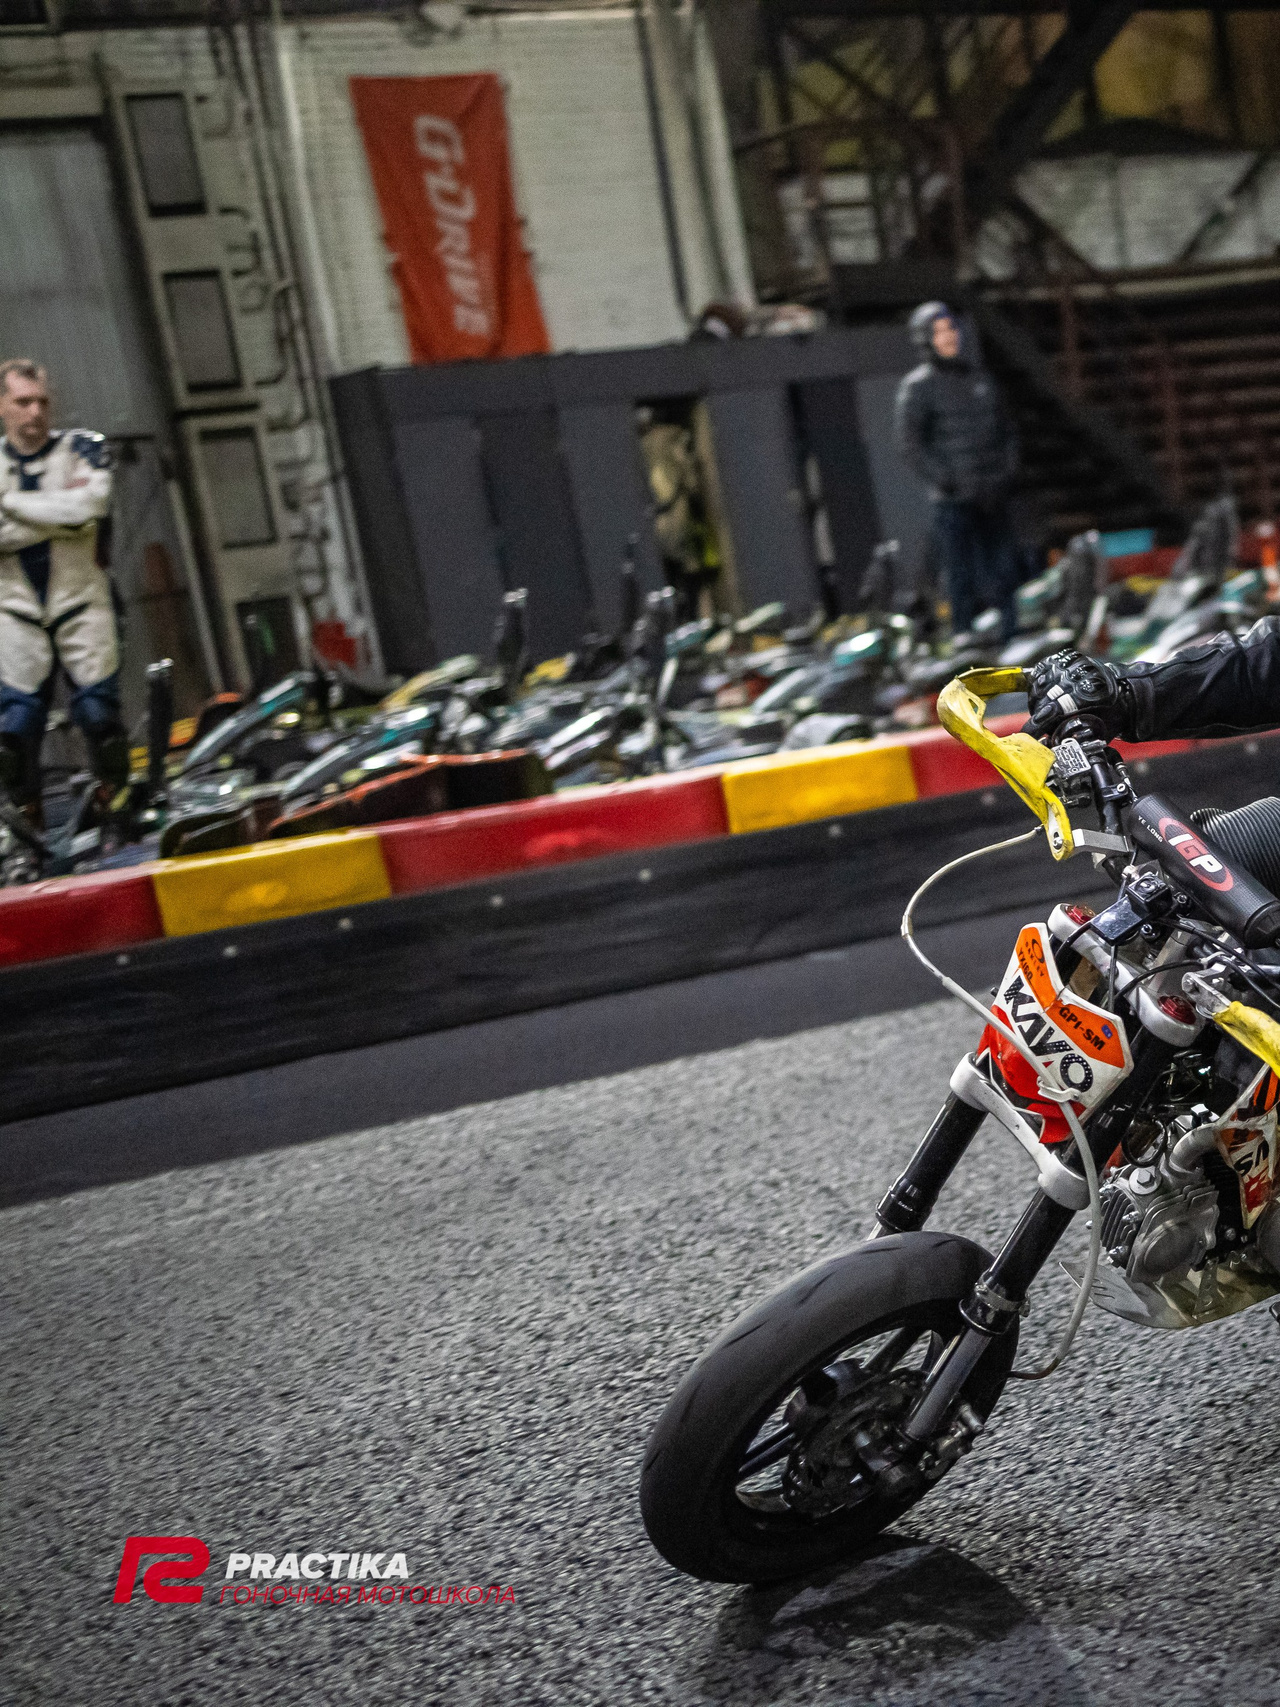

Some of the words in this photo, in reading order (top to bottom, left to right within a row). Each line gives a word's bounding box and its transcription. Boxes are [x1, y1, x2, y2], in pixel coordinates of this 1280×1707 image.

[1146, 824, 1164, 843] LONG
[1167, 833, 1223, 873] IGP
[1003, 975, 1094, 1093] KAYO
